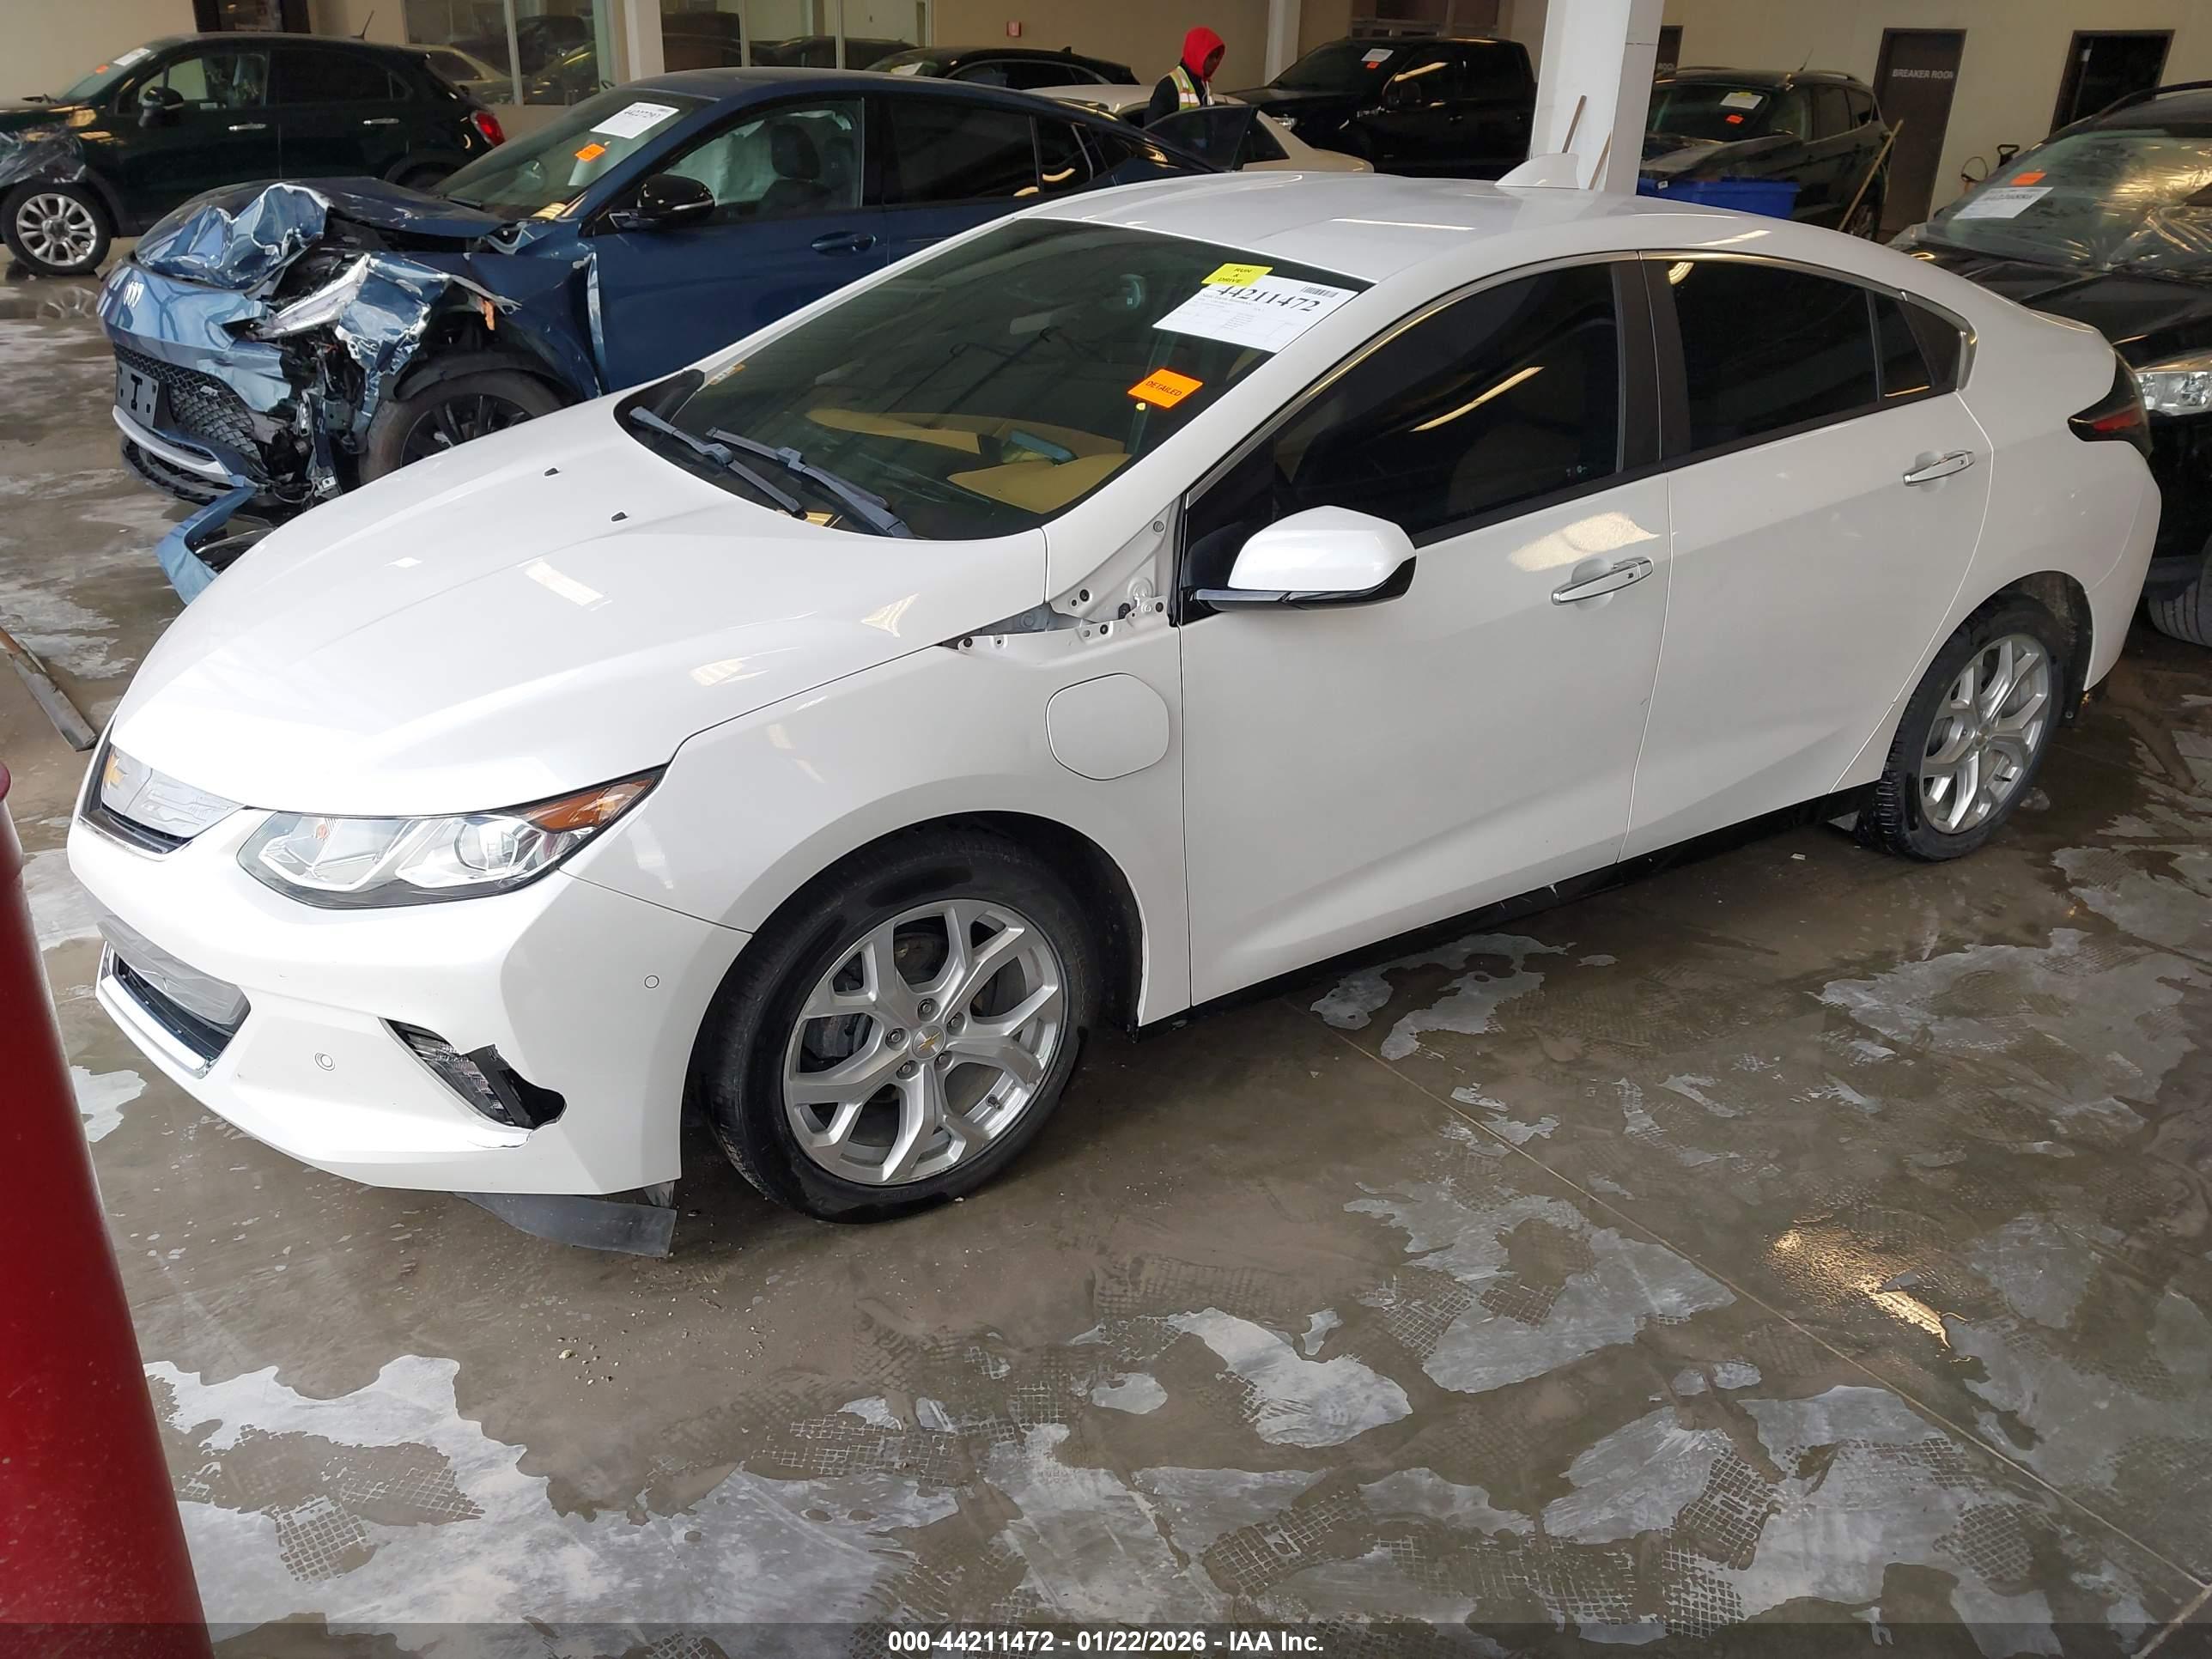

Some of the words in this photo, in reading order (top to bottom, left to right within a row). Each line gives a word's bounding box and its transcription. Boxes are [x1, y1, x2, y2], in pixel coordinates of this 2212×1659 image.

[1892, 69, 1930, 78] BREAKER
[1217, 285, 1321, 312] 44211472
[1146, 380, 1182, 397] DETAILED
